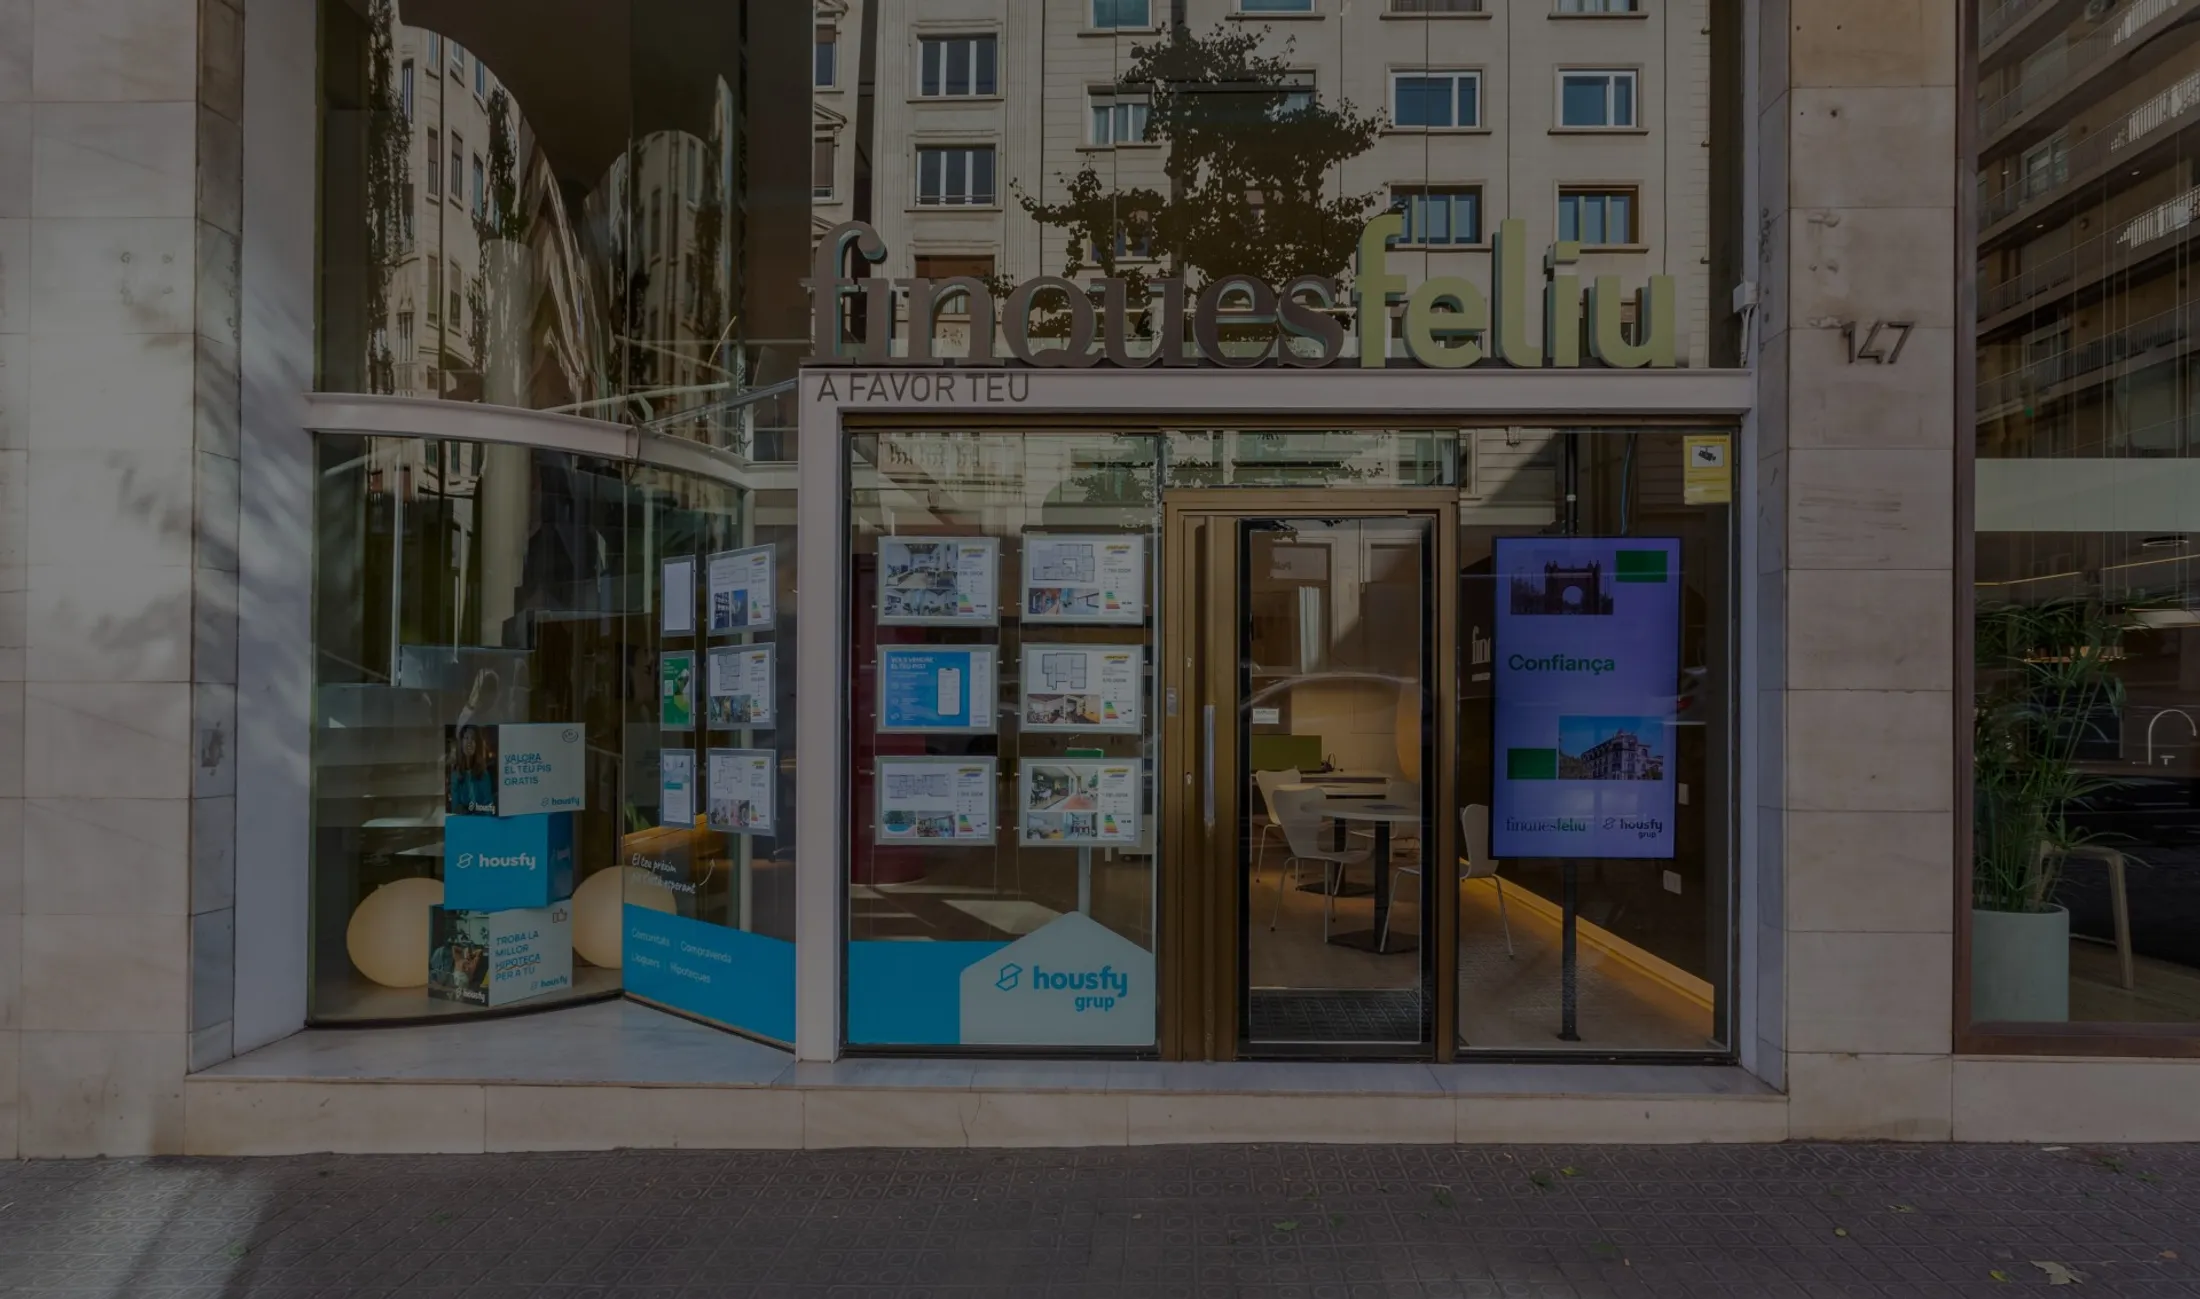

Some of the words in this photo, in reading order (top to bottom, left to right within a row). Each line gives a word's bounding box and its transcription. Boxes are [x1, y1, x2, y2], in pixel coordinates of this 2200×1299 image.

[1841, 321, 1914, 364] 147
[817, 373, 838, 401] A
[850, 373, 955, 401] FAVOR
[966, 373, 1028, 402] TEU
[1508, 654, 1615, 676] Confiança
[504, 753, 542, 764] VALORA
[504, 766, 516, 775] EL
[518, 765, 535, 774] TEU
[536, 764, 552, 773] PIS
[551, 796, 580, 806] housfy
[1620, 818, 1663, 833] housfy
[478, 851, 537, 871] housfy
[495, 934, 525, 946] TROBA
[527, 930, 540, 940] LA
[495, 944, 530, 956] MILLOR
[681, 940, 732, 964] Compravenda
[495, 953, 541, 970] HIPOTECA
[540, 974, 568, 988] housfy
[1033, 964, 1127, 997] housfy
[1074, 995, 1115, 1012] grup
